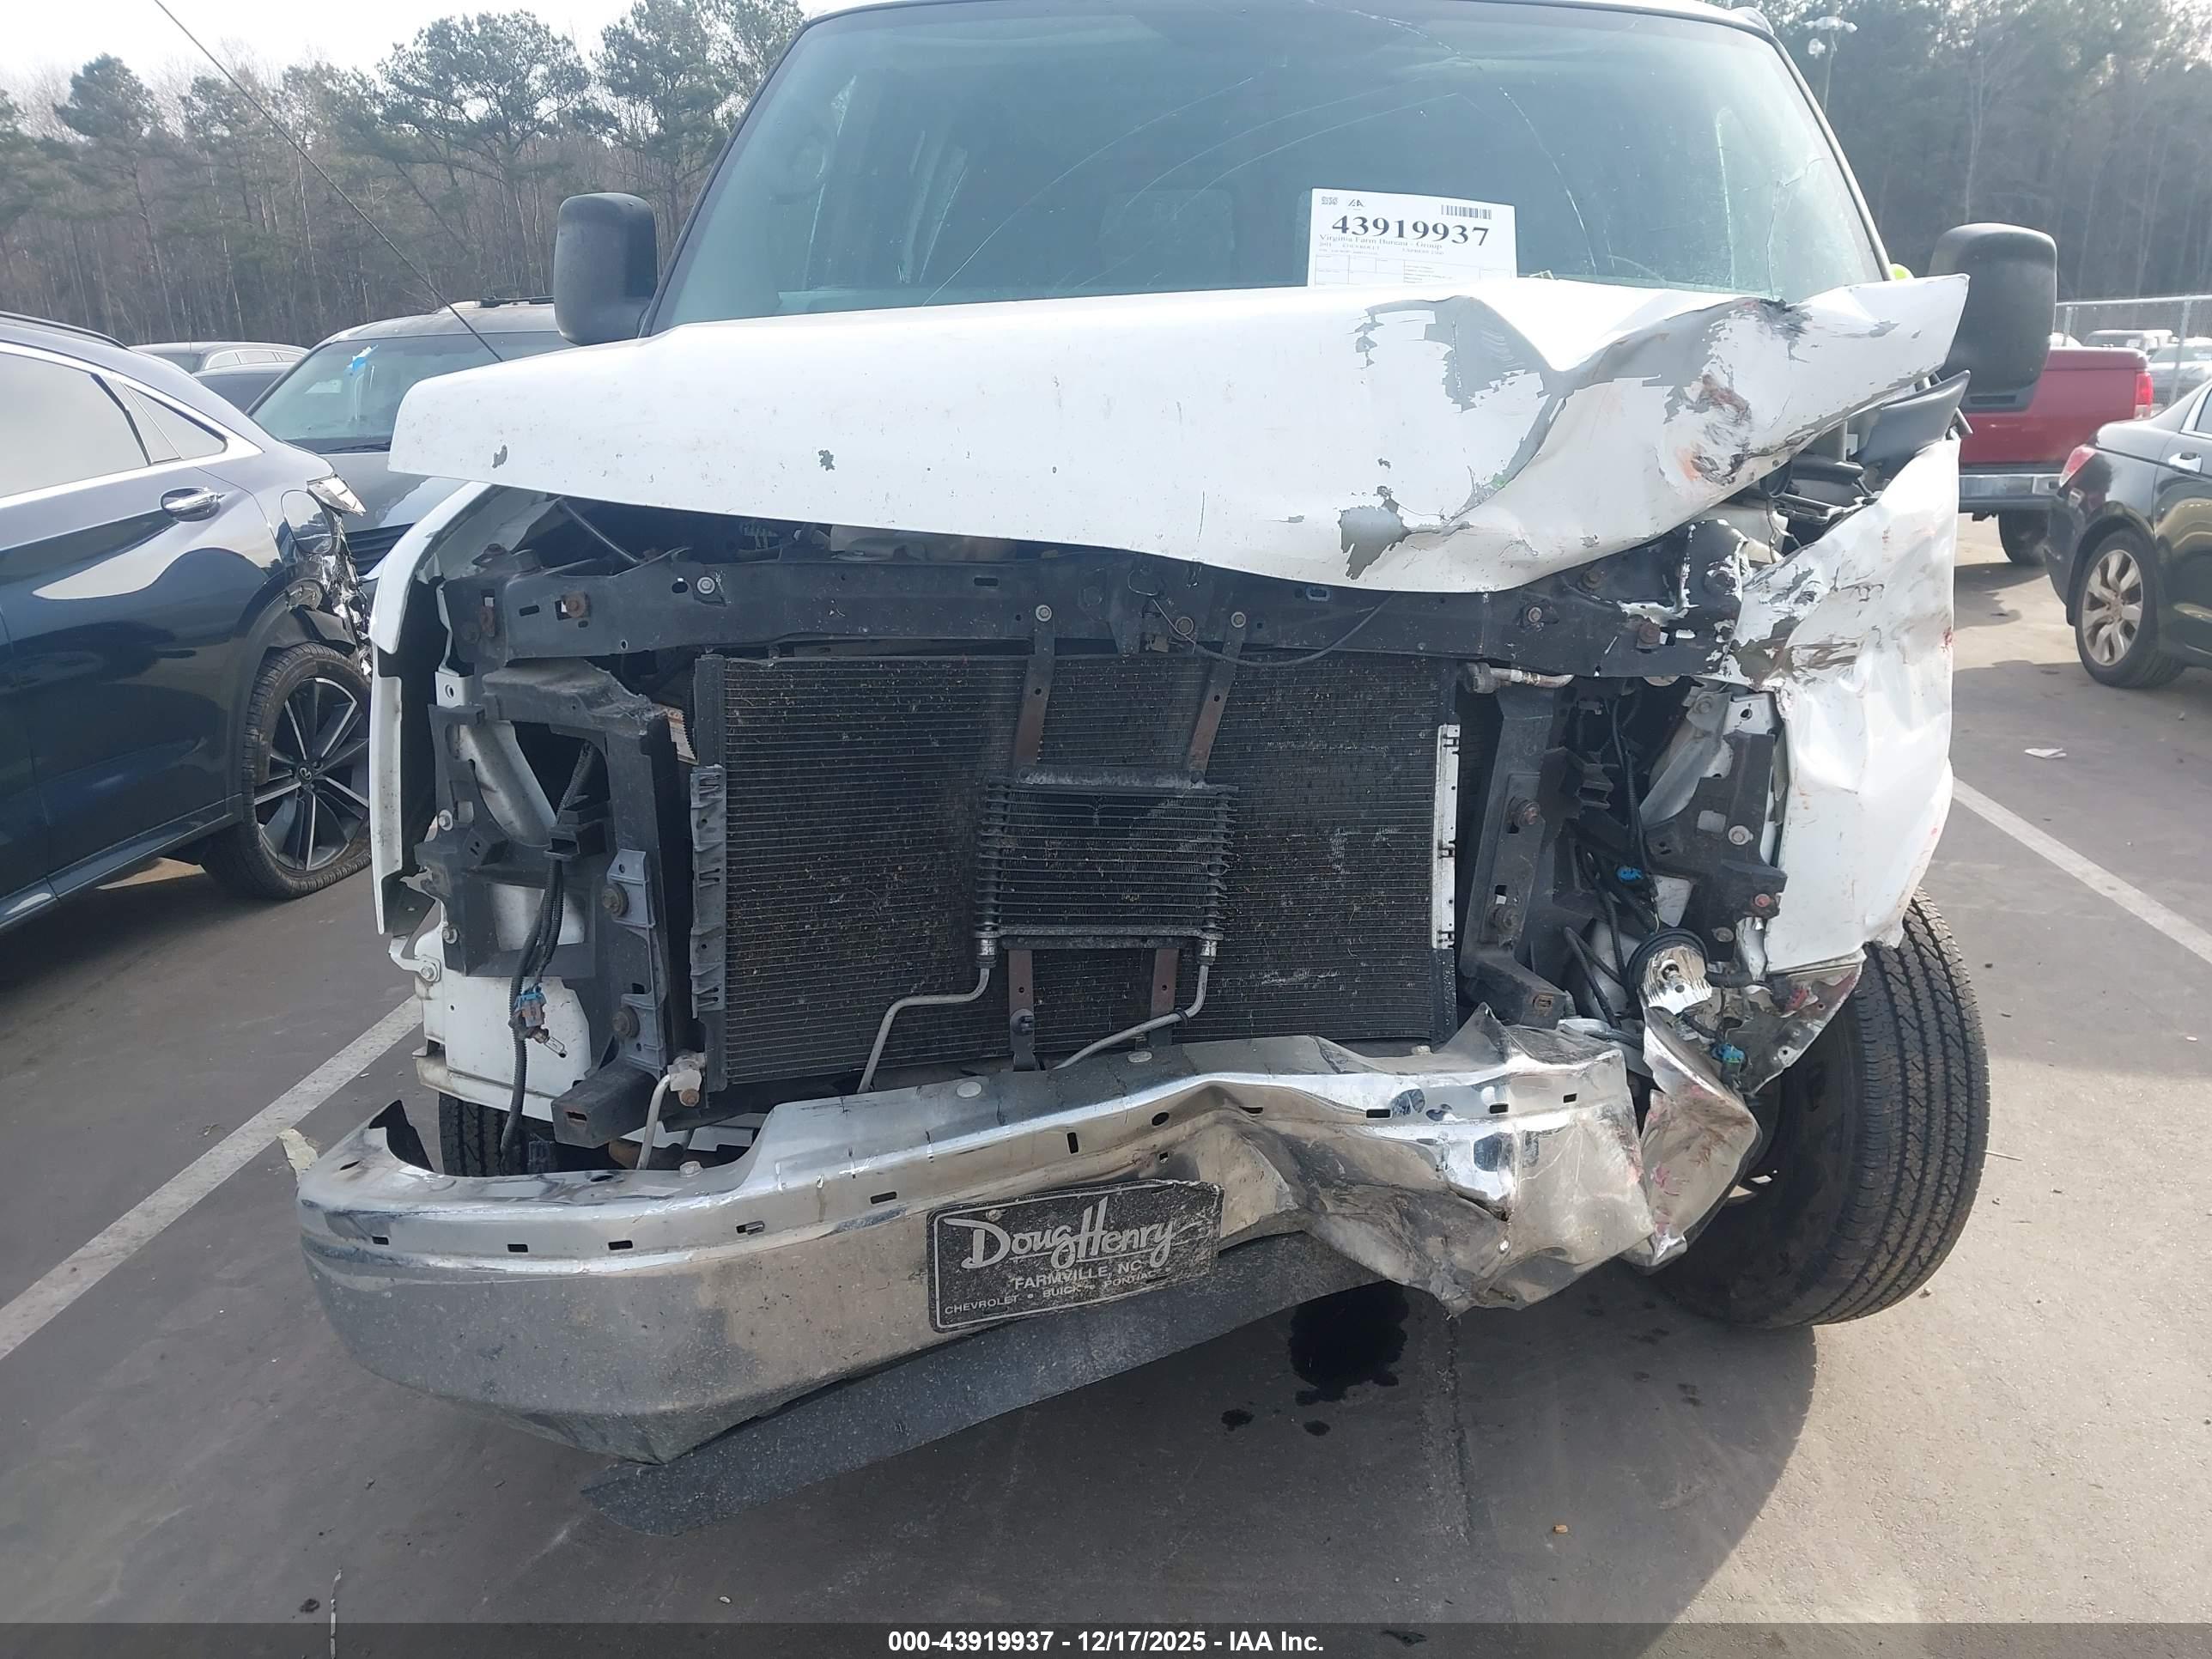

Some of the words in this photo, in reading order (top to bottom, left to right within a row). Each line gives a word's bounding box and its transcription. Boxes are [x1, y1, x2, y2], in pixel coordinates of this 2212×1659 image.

[1319, 234, 1352, 243] Virginia
[1416, 241, 1443, 250] Group
[1332, 215, 1489, 246] 43919937
[1117, 1260, 1142, 1274] NC
[945, 1294, 1019, 1315] CHEVROLET
[1042, 1285, 1082, 1297] BUICK
[1103, 1270, 1157, 1288] PONTIAC
